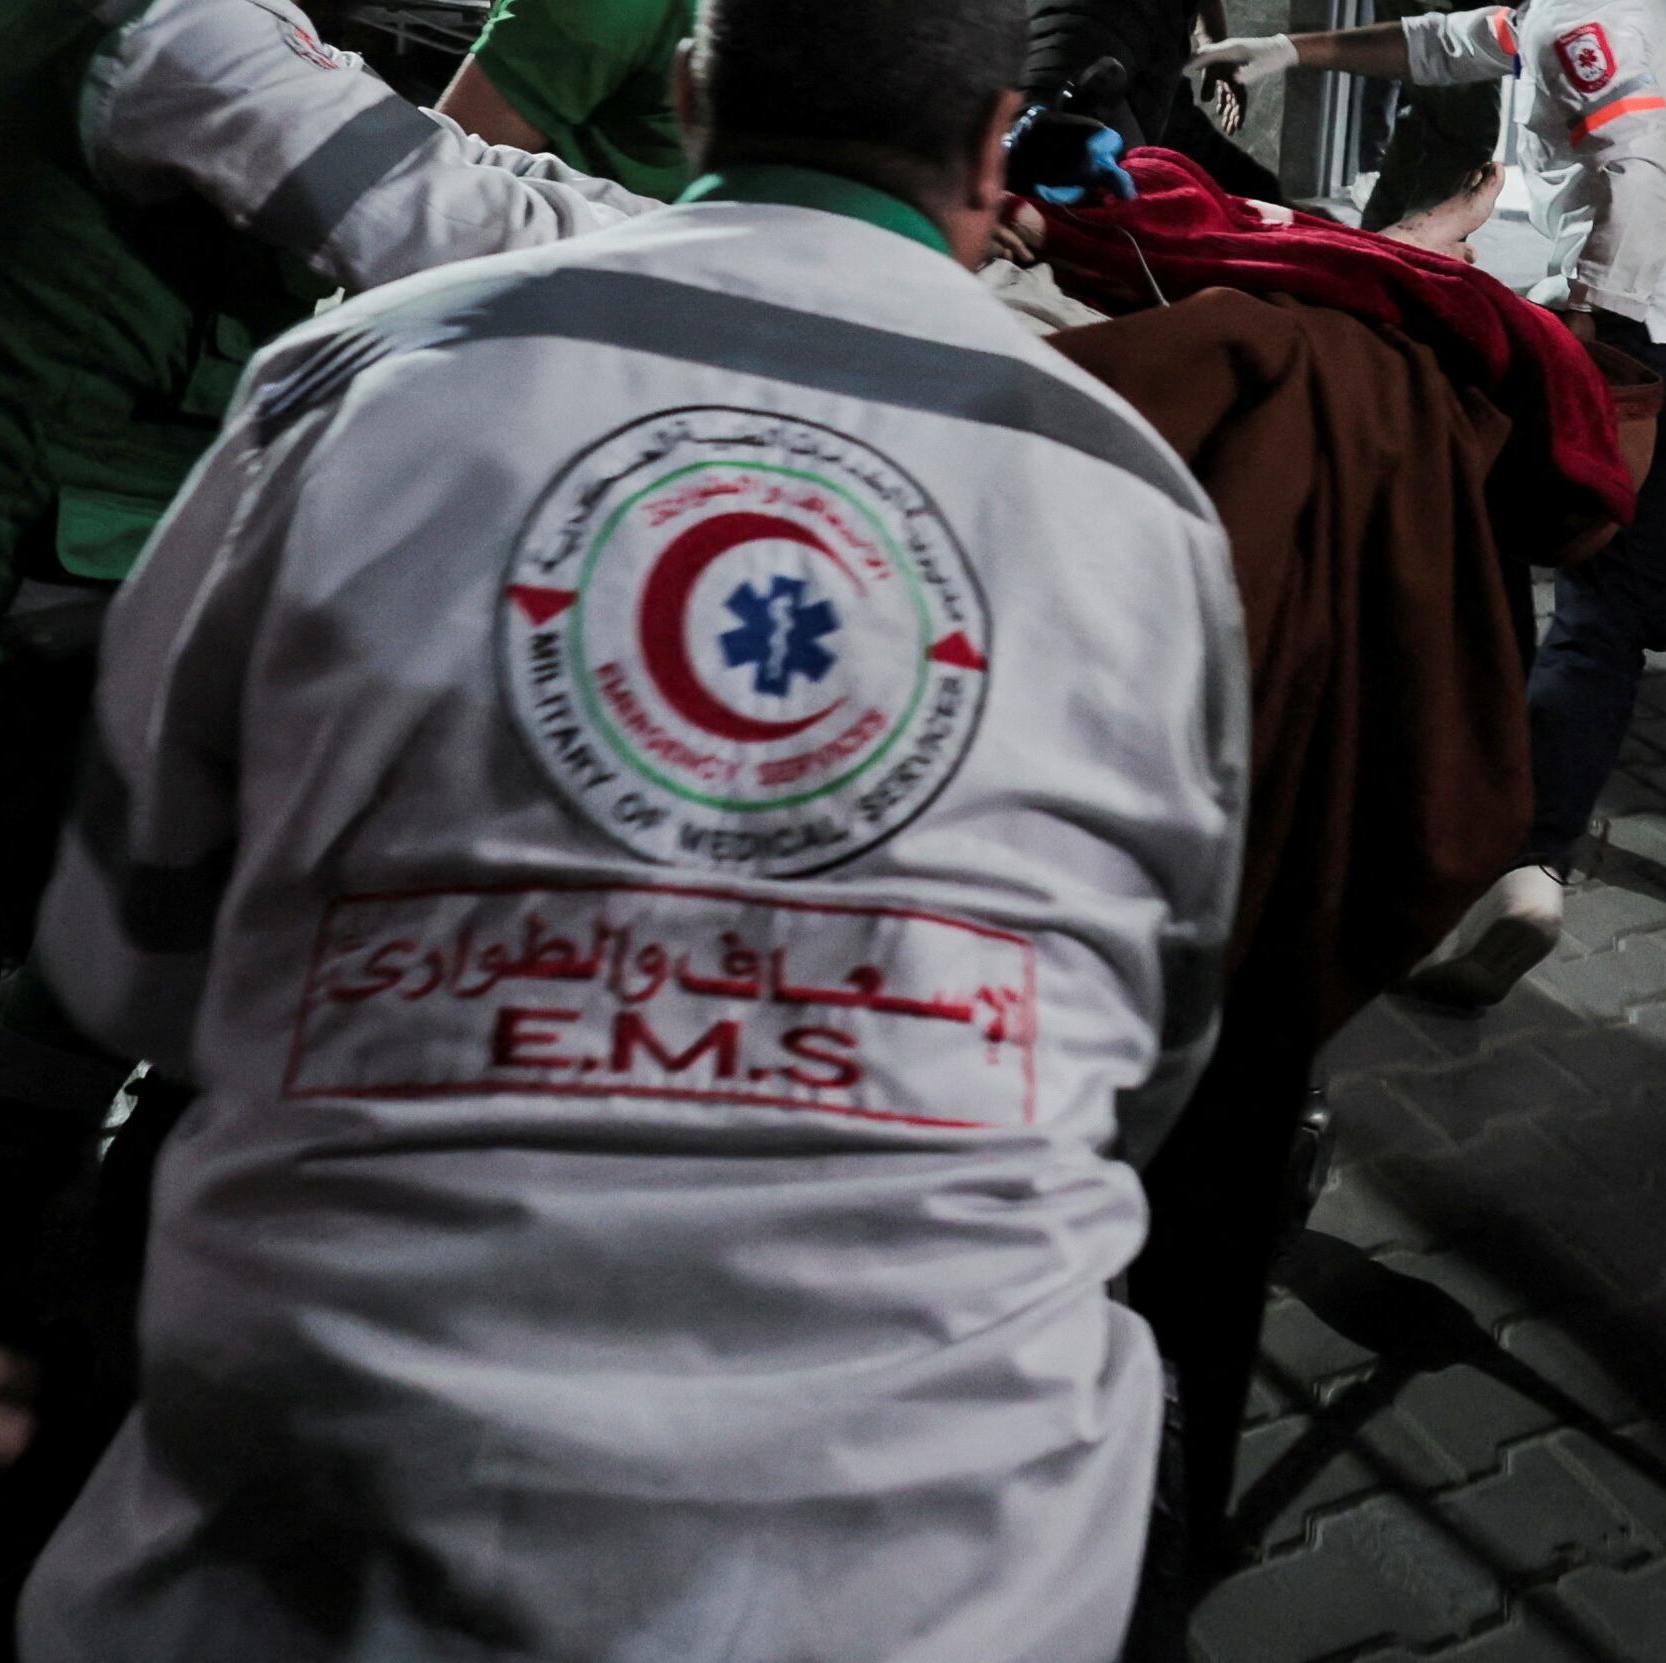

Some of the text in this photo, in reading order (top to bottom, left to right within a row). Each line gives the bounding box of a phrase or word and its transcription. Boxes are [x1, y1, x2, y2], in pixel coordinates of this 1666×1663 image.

[529, 632, 619, 790] MILITARY
[612, 790, 671, 831] OF
[679, 818, 851, 862] MEDICAL
[491, 1007, 863, 1088] E.M.S
